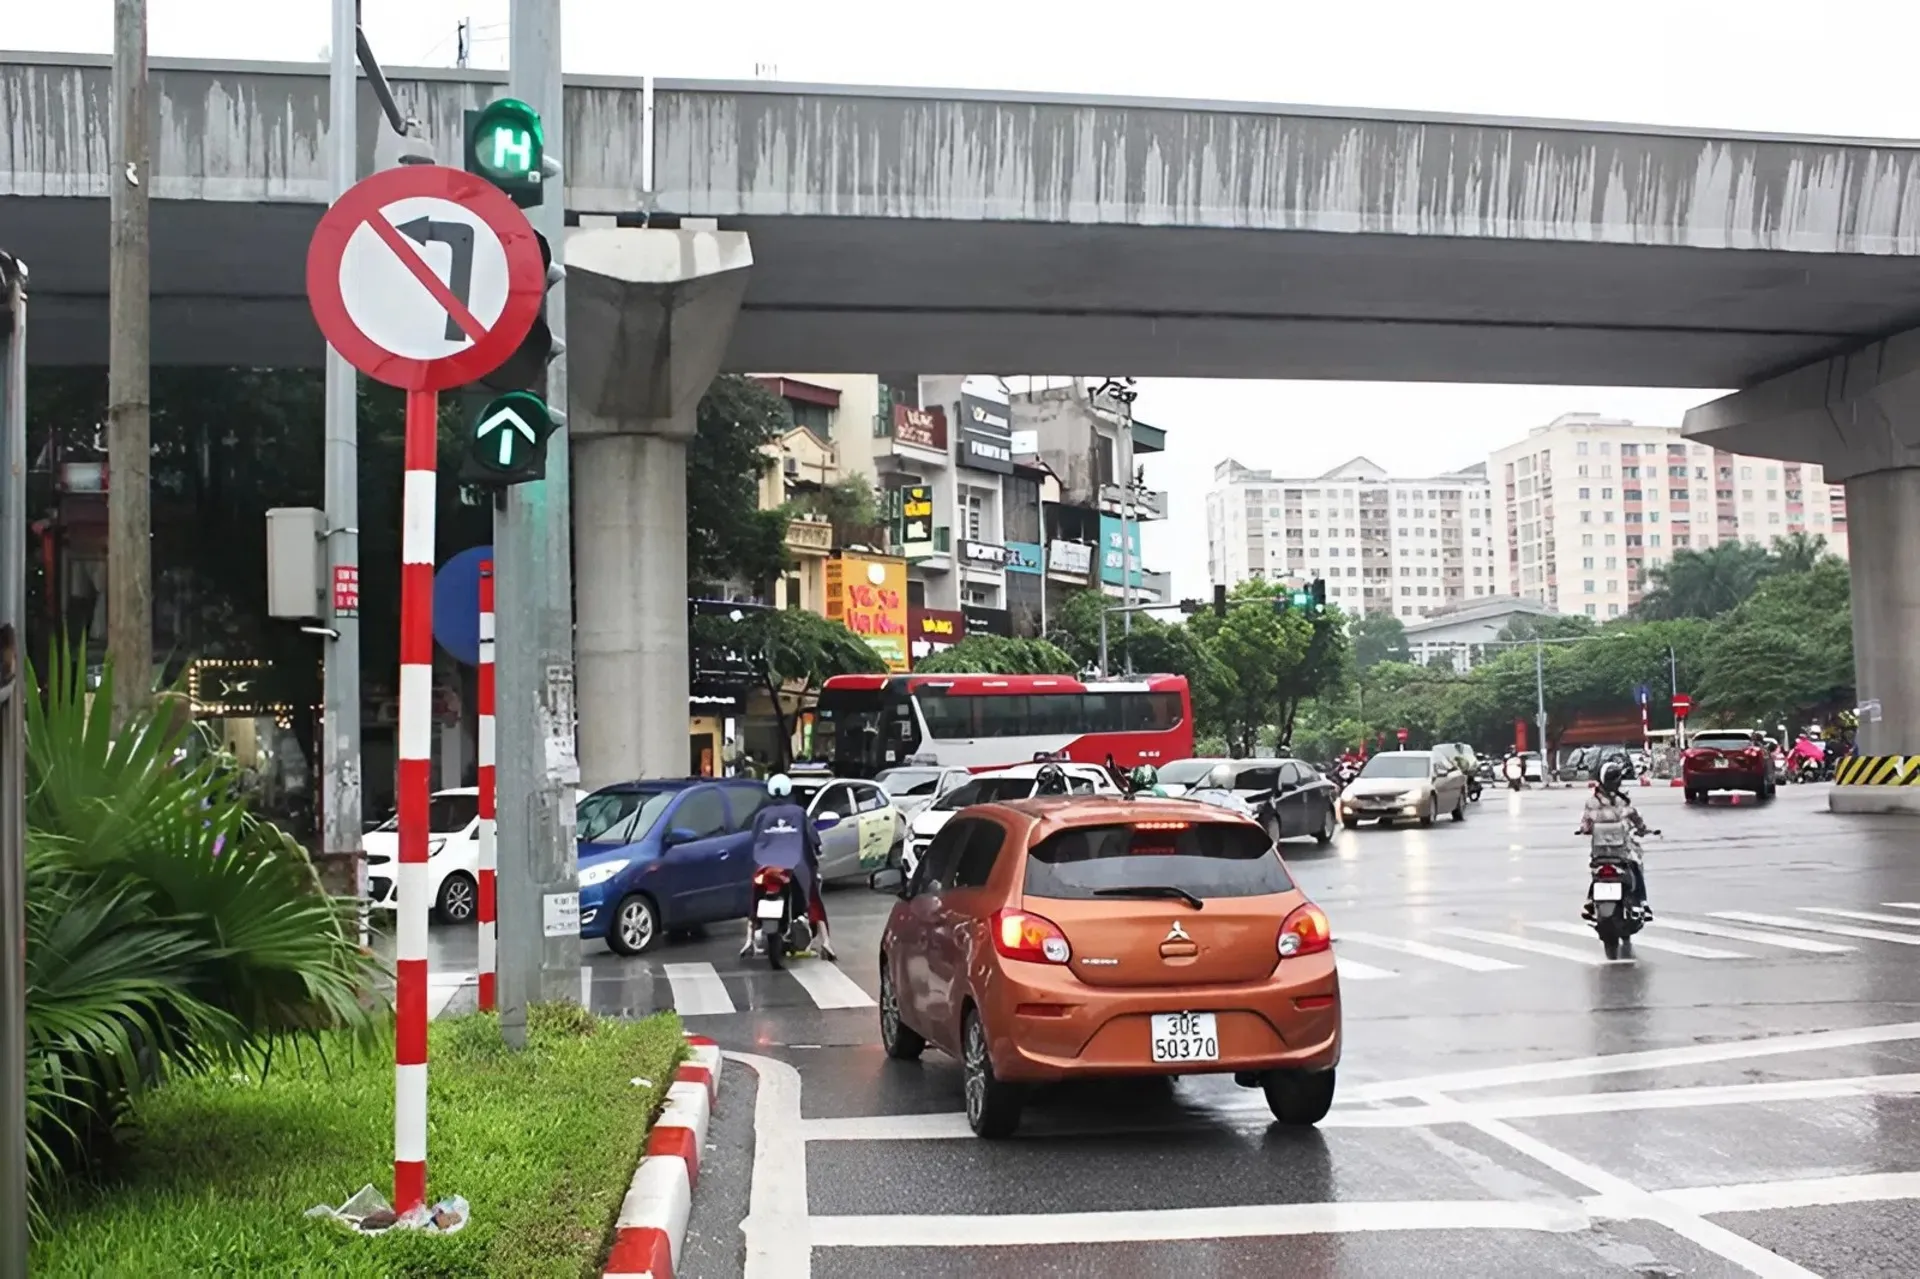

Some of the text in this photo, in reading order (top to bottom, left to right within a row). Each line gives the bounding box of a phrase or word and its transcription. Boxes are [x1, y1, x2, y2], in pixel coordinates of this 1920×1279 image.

[494, 126, 531, 171] 14
[1167, 1014, 1201, 1036] 30E
[1156, 1037, 1216, 1059] 50370
